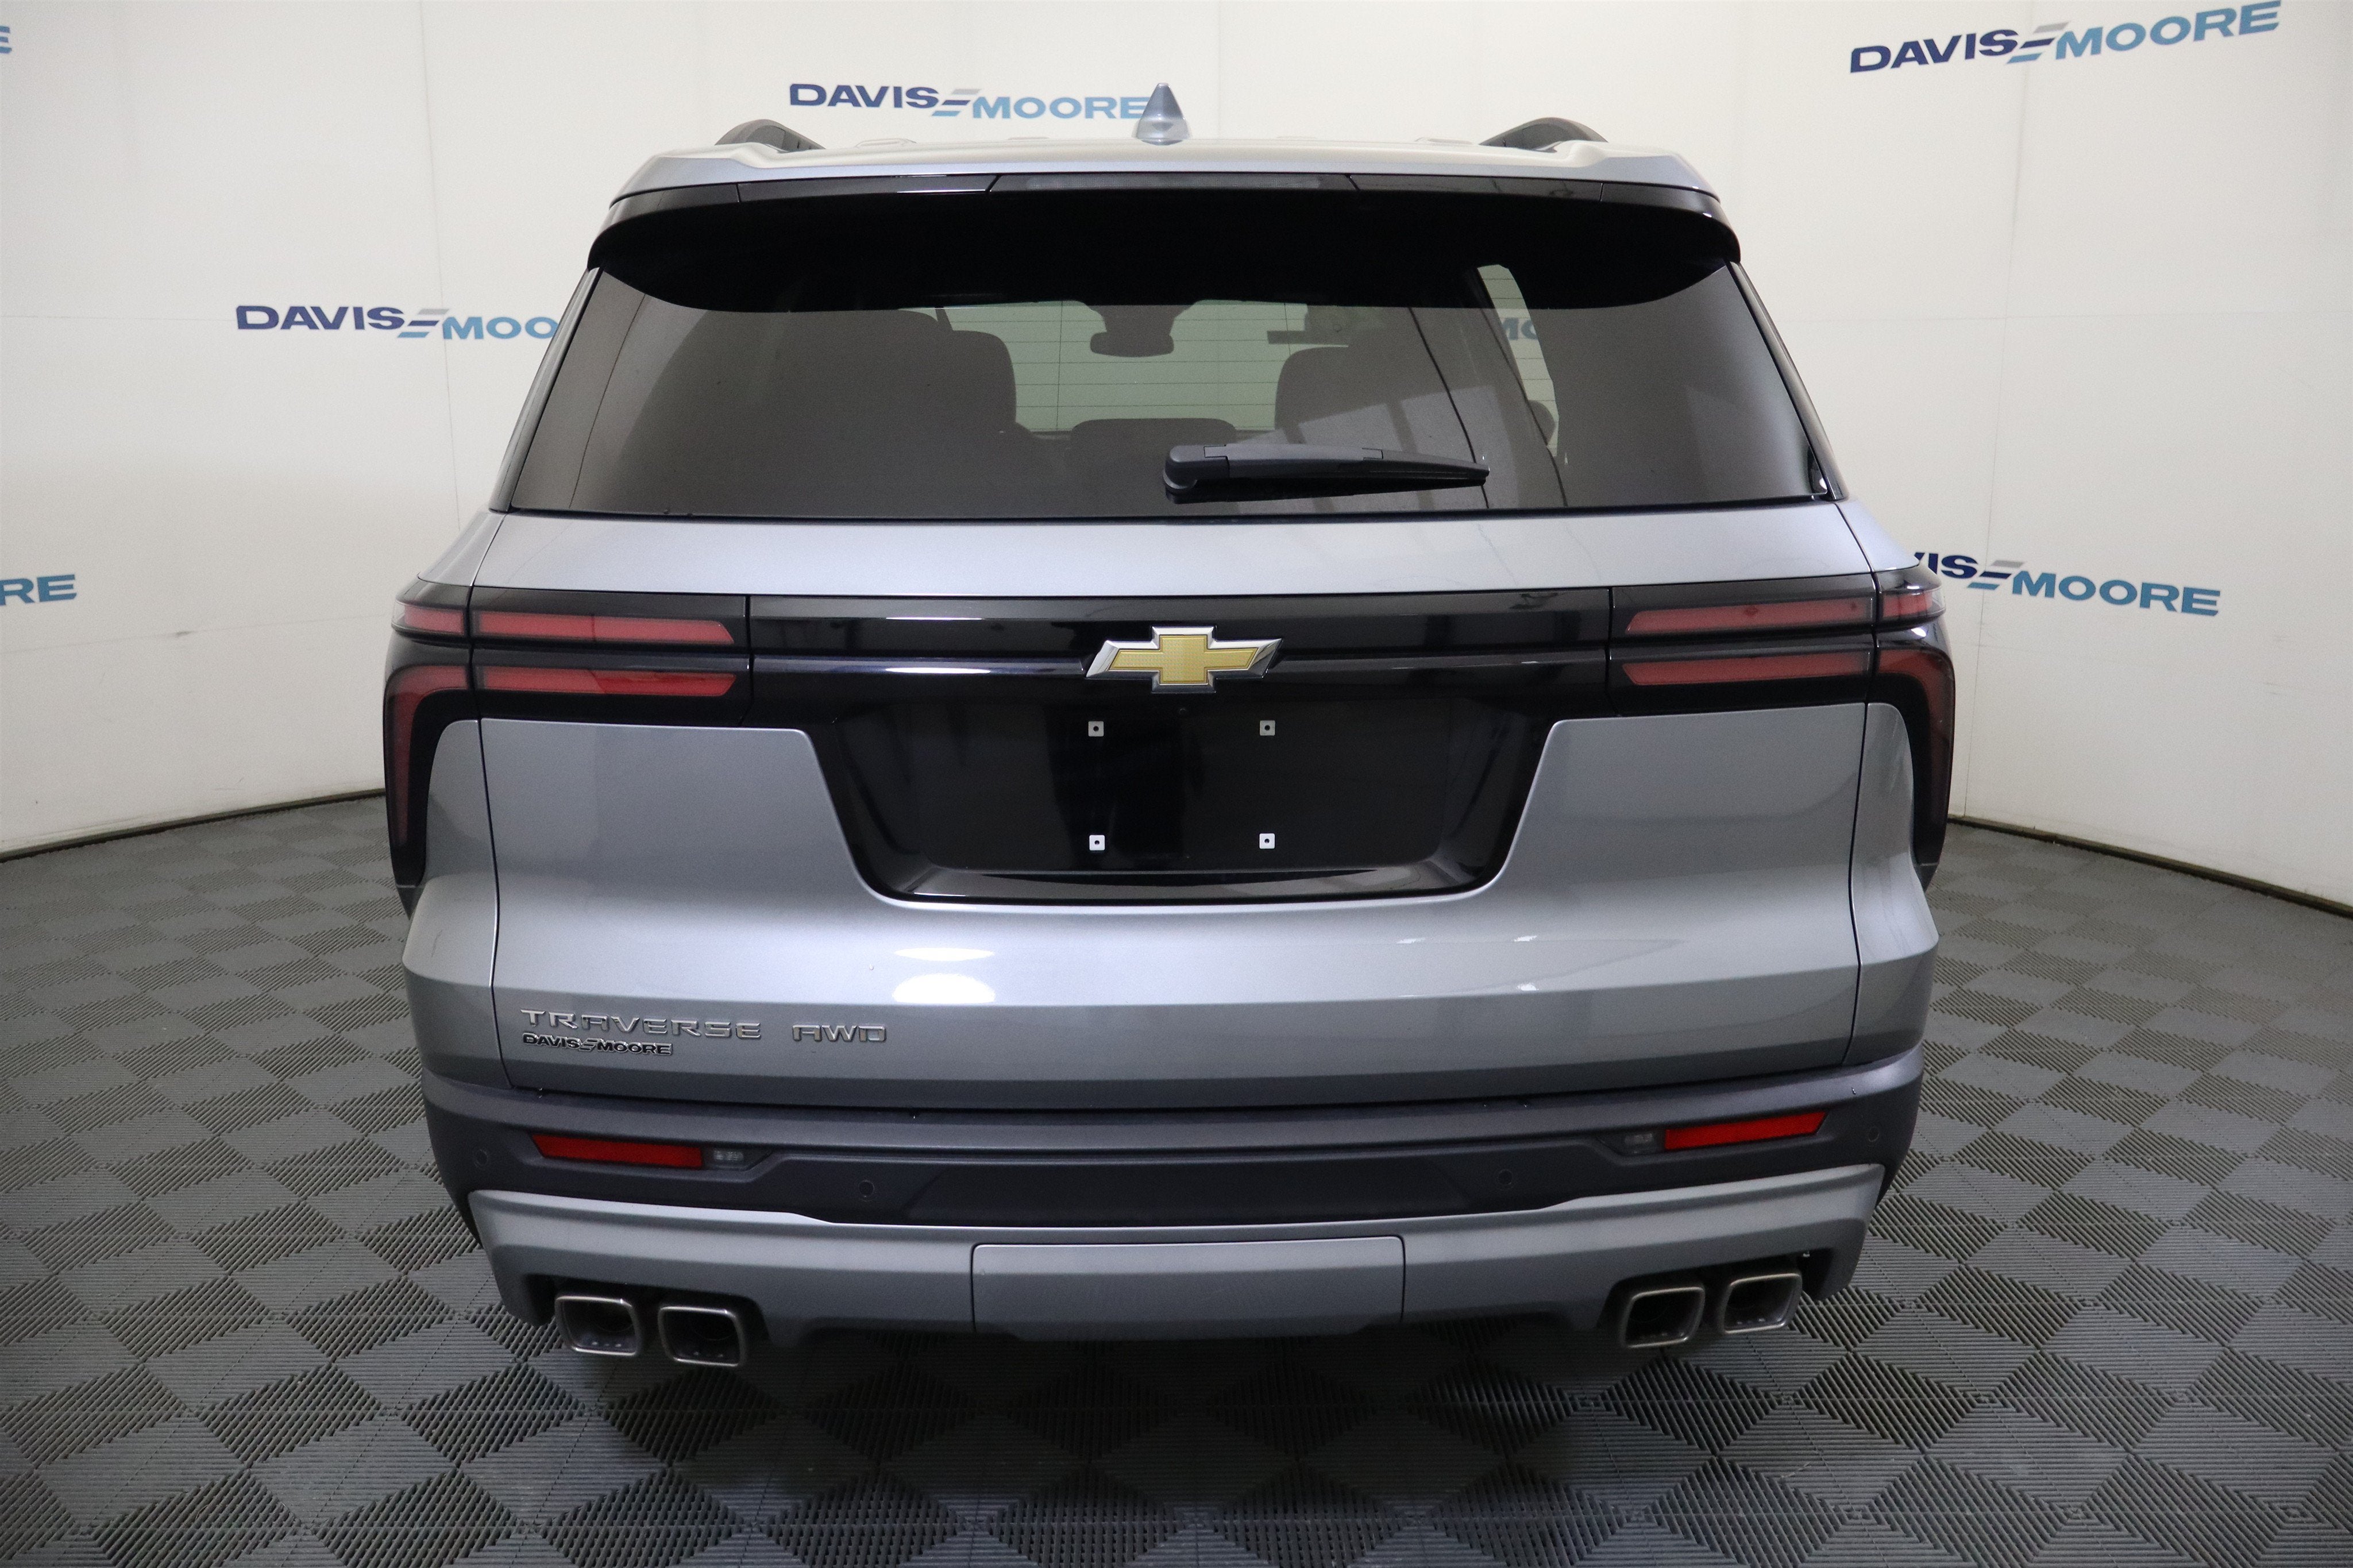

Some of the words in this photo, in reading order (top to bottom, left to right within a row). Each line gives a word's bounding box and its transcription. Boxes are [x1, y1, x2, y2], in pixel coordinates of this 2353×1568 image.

[1849, 29, 2018, 73] DAVIS
[2055, 1, 2281, 60] MOORE
[789, 83, 939, 109] DAVIS
[973, 96, 1150, 119] MOORE
[236, 306, 405, 330] DAVIS
[2012, 571, 2220, 616] MOORE
[520, 1009, 762, 1040] TRAVERSE
[791, 1024, 888, 1042] AWD
[522, 1033, 581, 1049] DAVIS
[596, 1038, 673, 1056] MOORE
